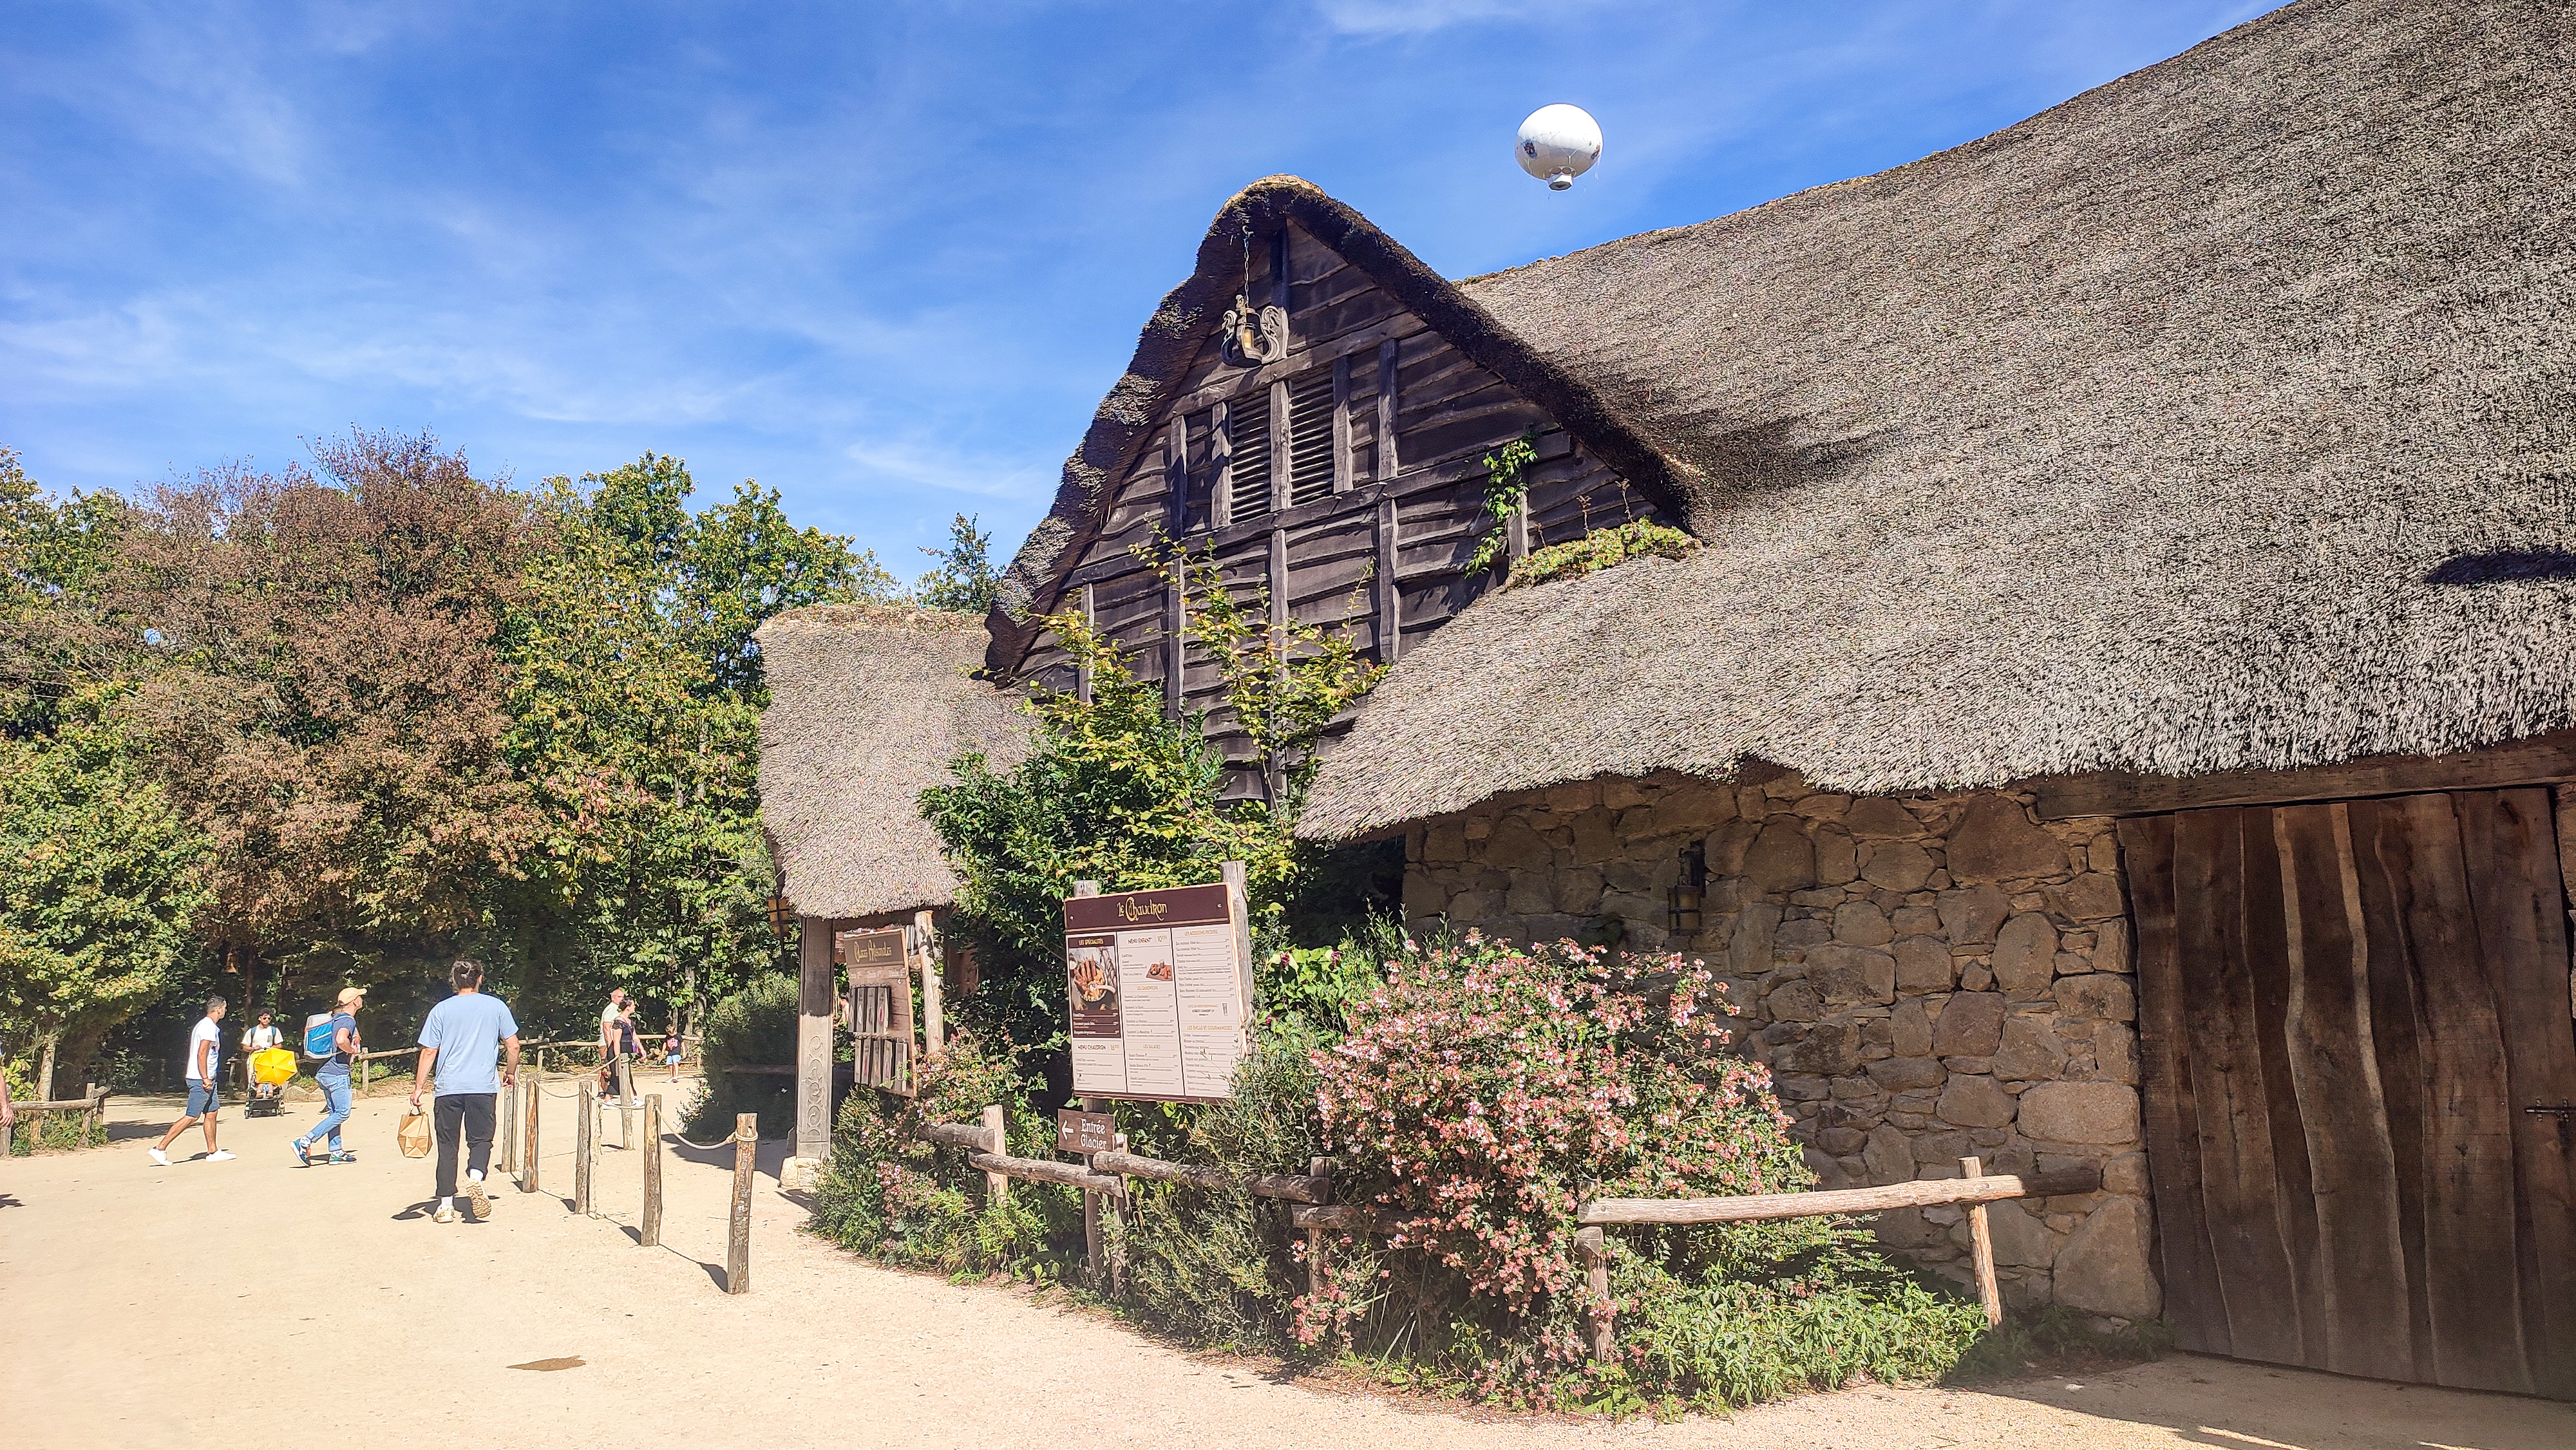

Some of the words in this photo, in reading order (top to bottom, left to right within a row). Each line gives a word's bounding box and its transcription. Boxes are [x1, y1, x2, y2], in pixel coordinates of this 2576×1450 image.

[1117, 901, 1124, 918] Le
[1125, 896, 1168, 921] Chaudron
[1081, 1118, 1106, 1135] Entrée
[1080, 1133, 1107, 1150] Glacier
